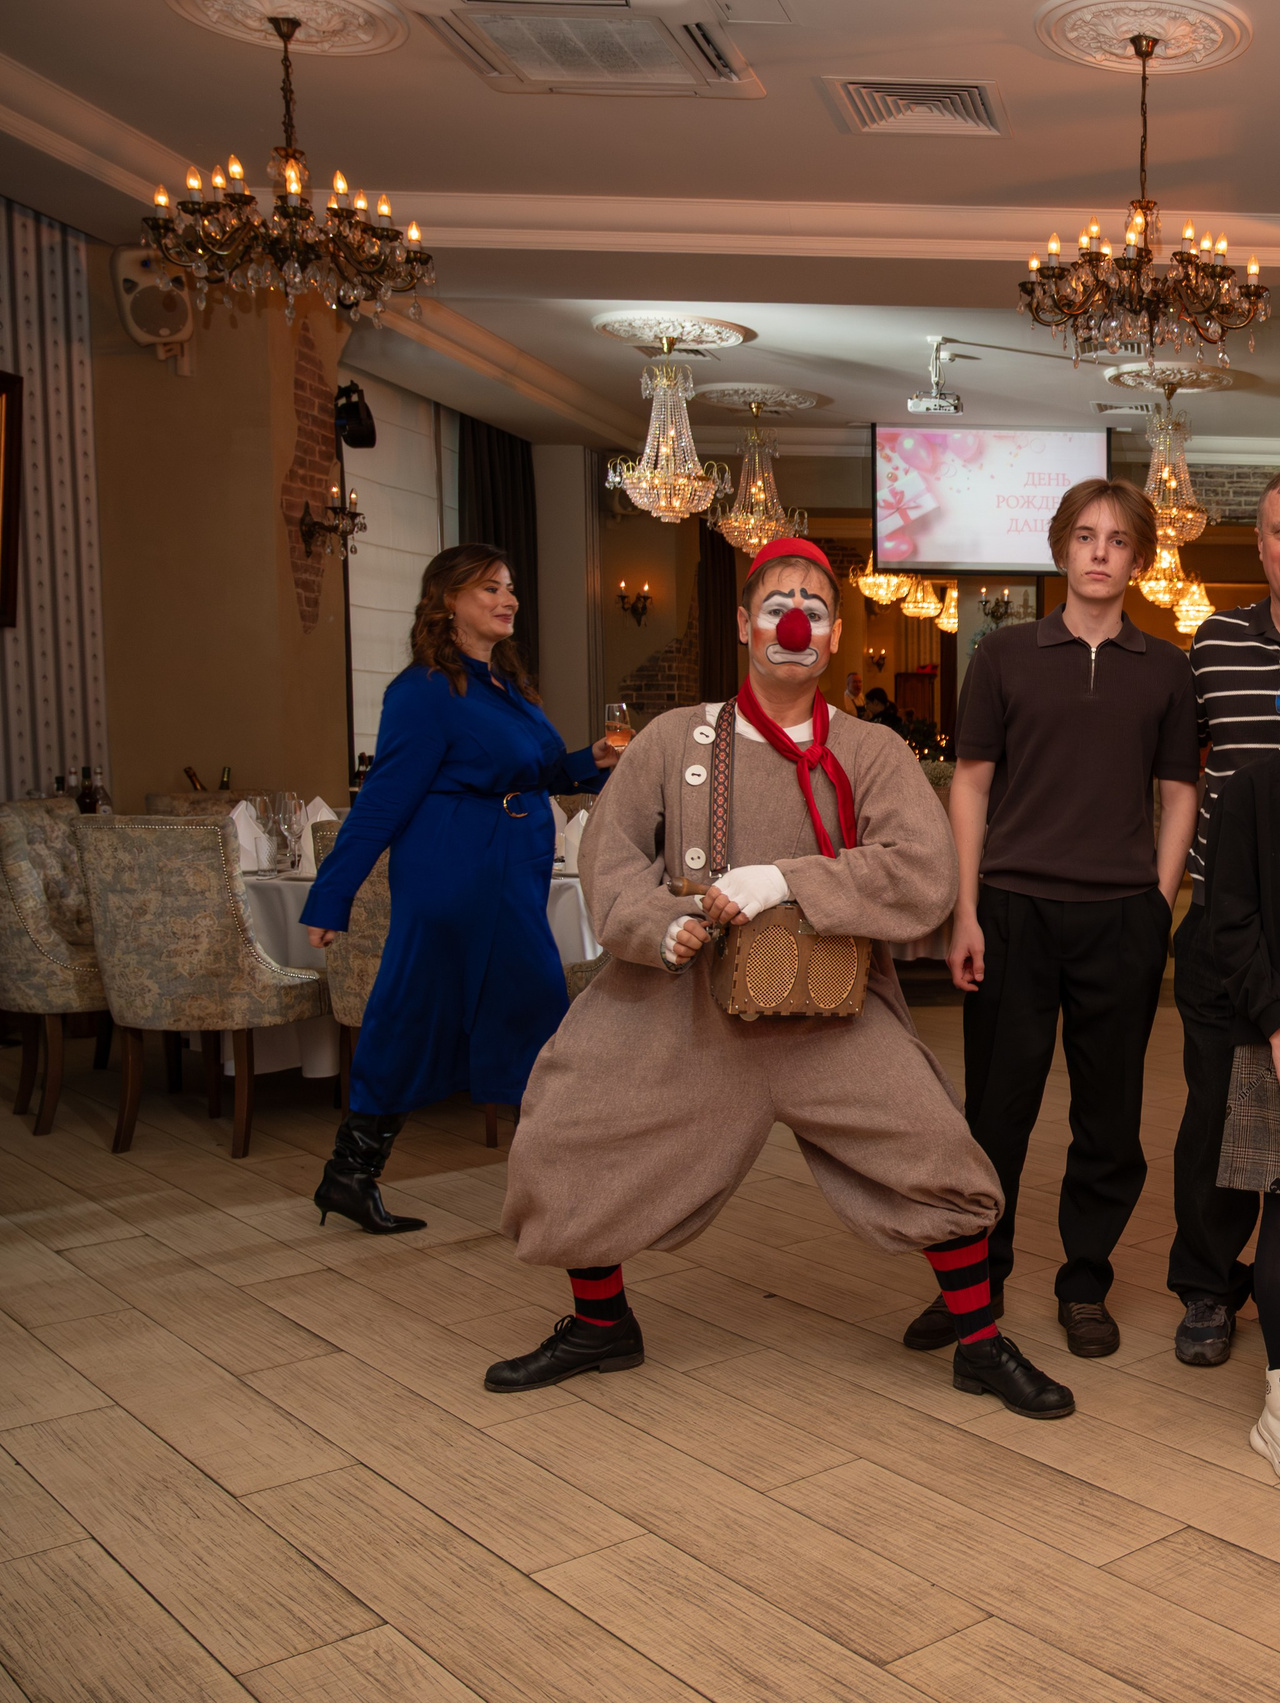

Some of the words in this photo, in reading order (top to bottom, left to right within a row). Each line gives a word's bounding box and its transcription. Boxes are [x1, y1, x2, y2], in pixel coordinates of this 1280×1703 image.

[1024, 472, 1071, 488] ДЕНЬ
[996, 495, 1062, 511] РОЖДЕ
[1007, 518, 1051, 534] ДАШ
